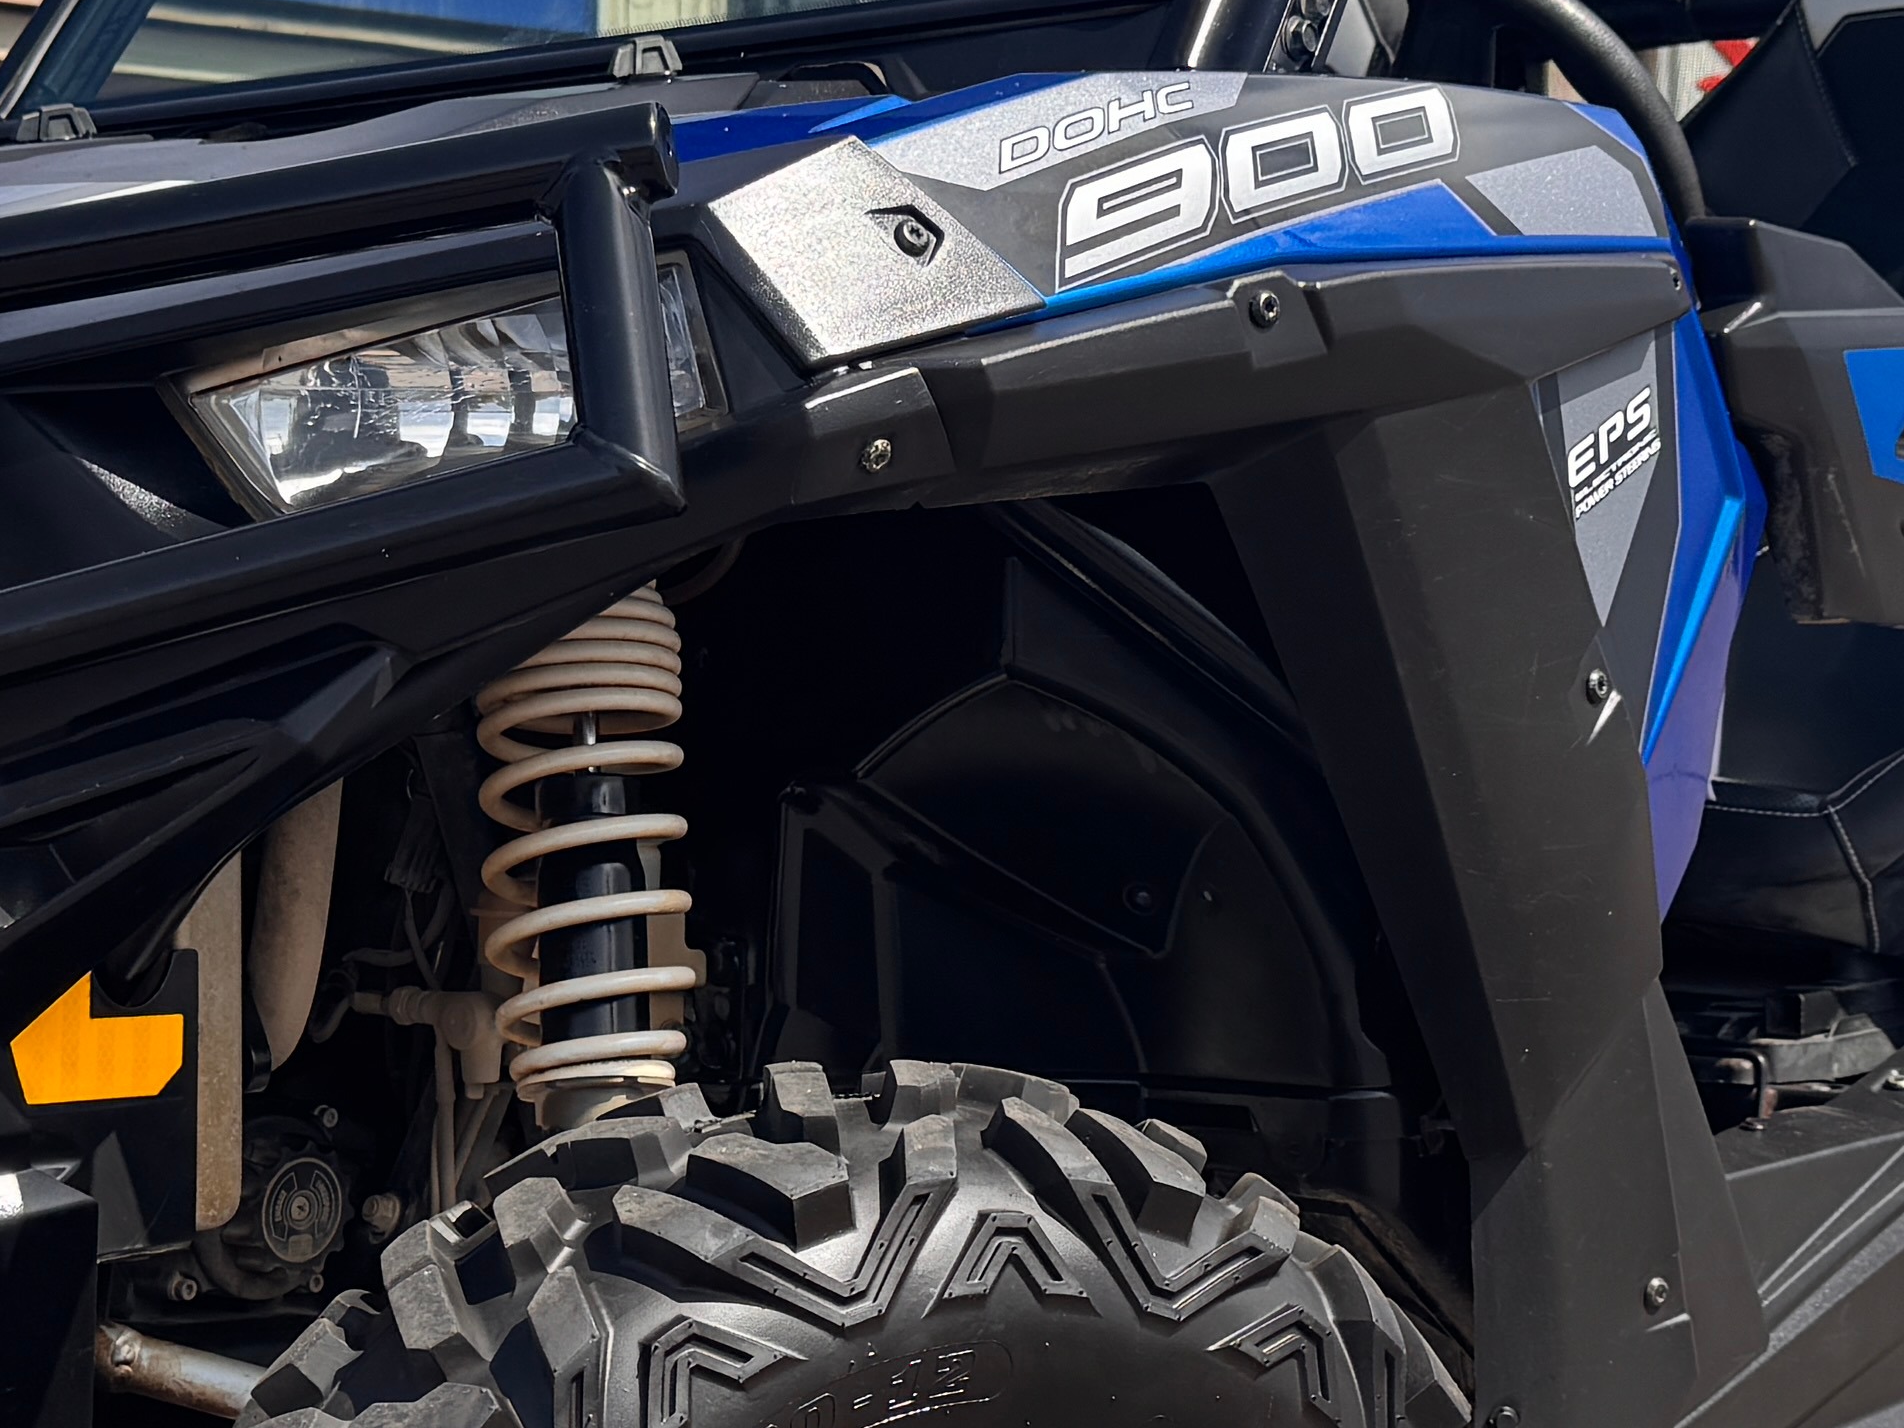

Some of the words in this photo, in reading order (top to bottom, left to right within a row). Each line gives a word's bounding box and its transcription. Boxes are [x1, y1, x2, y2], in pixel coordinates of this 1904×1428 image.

[998, 81, 1194, 174] DOHC
[1056, 84, 1460, 291] 900
[1567, 386, 1652, 489] EPS
[1575, 478, 1615, 520] POWER
[1614, 437, 1662, 487] STEERING
